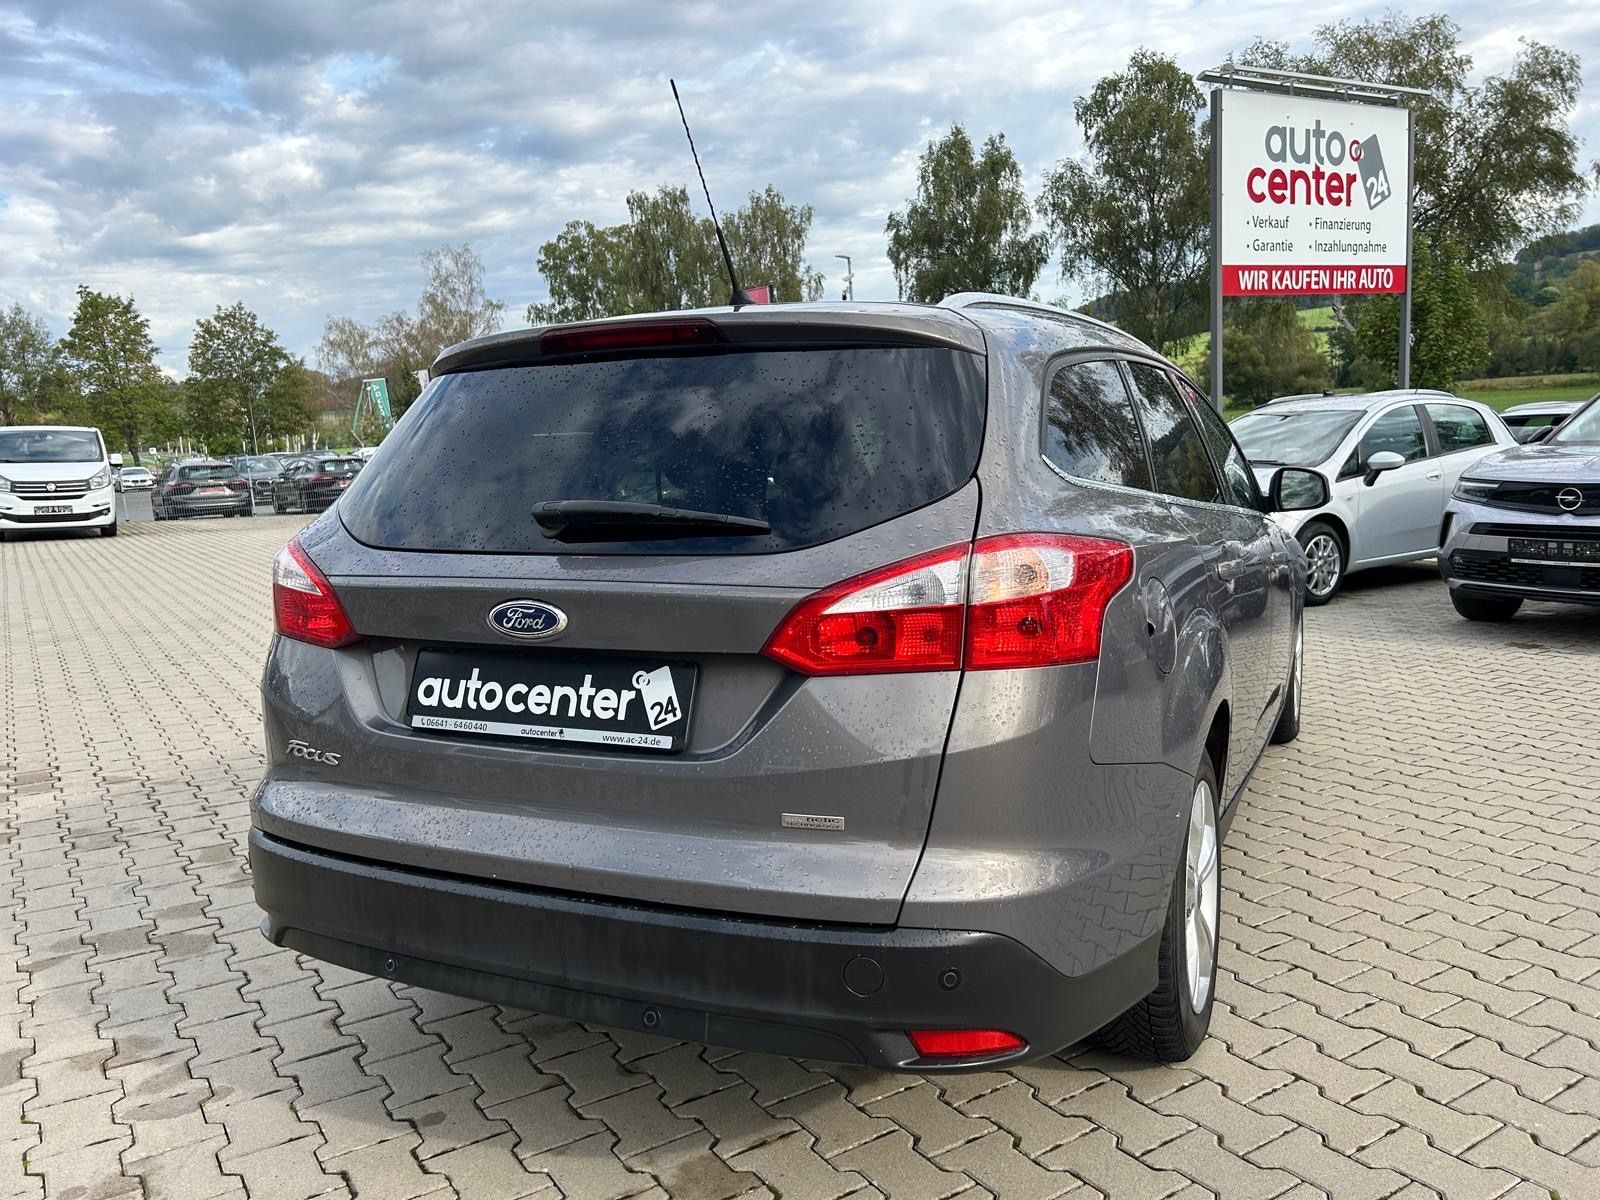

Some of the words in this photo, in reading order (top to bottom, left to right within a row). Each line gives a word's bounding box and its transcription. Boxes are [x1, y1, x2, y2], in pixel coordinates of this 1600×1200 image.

[1265, 119, 1346, 167] auto
[1246, 162, 1357, 207] center
[1366, 170, 1388, 205] 24
[1252, 215, 1290, 230] Verkauf
[1314, 217, 1372, 234] Finanzierung
[1252, 239, 1294, 253] Garantie
[1314, 239, 1387, 256] Inzahlungnahme
[1238, 270, 1269, 291] WIR
[1271, 269, 1330, 290] KAUFEN
[1333, 270, 1356, 290] IHR
[1359, 268, 1394, 289] AUTO
[502, 607, 546, 630] Ford
[649, 695, 678, 727] 24
[520, 727, 558, 737] autocenter
[602, 735, 662, 746] www.ac-24.de
